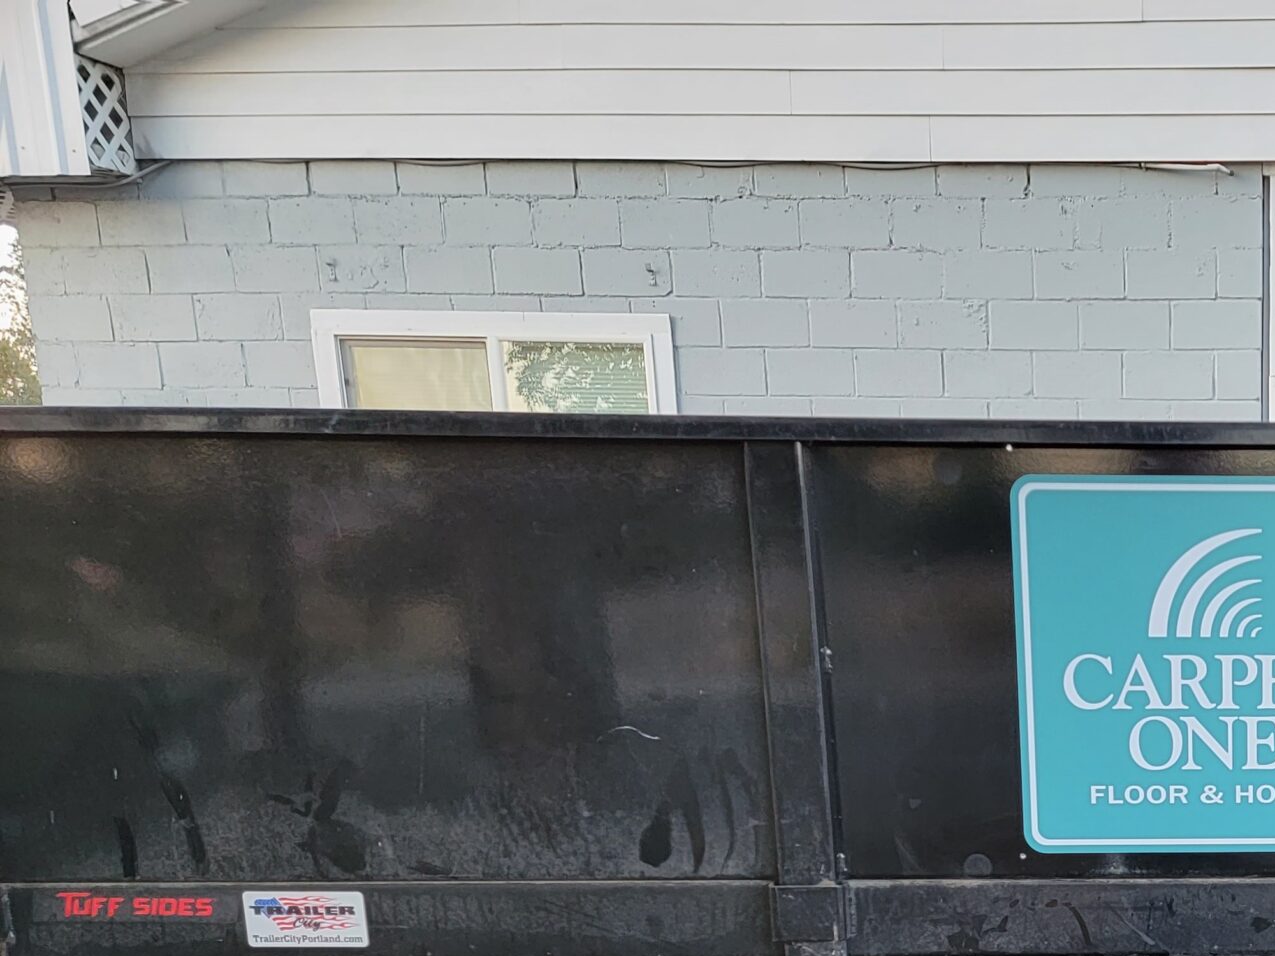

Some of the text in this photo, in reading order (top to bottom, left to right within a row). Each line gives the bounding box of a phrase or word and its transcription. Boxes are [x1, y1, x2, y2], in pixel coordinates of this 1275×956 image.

[1090, 785, 1189, 805] FLOOR
[1200, 785, 1224, 804] &
[55, 891, 215, 918] TUFF SIDES
[249, 905, 356, 916] TRAILER
[293, 917, 321, 932] City
[252, 935, 363, 944] TrailerCityPortland.com
